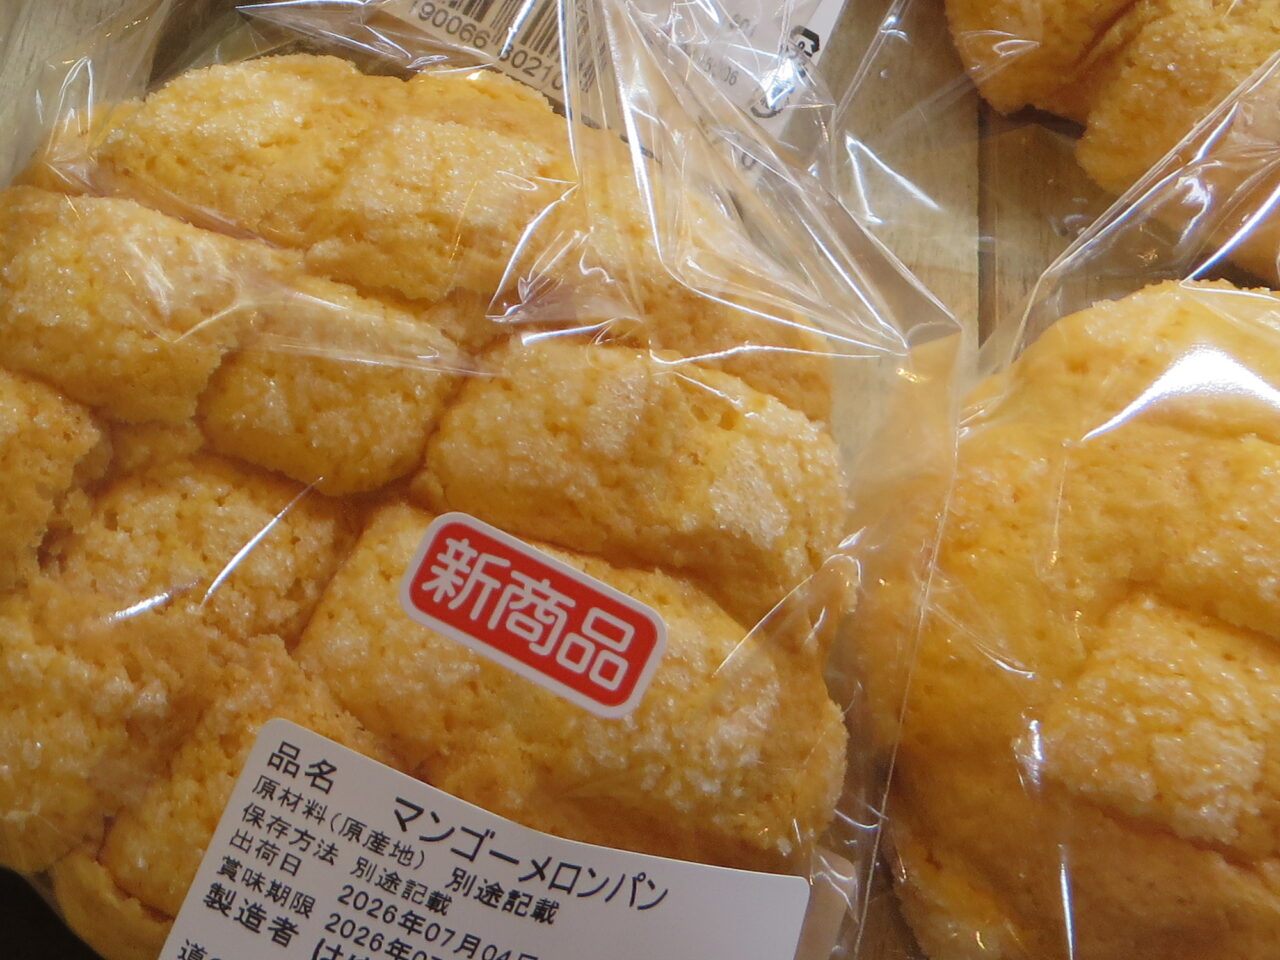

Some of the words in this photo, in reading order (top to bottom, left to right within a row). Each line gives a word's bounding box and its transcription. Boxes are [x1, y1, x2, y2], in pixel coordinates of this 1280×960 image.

[422, 538, 635, 691] 新商品
[216, 855, 316, 920] 賞味期限
[242, 803, 339, 867] 保存方法
[349, 856, 453, 917] 別途記載
[251, 774, 426, 871] 原材料(原産地)
[444, 867, 561, 925] 別途記載
[267, 740, 338, 795] 品名
[393, 796, 669, 911] マンゴーメロンパン
[202, 882, 300, 949] 製造者
[228, 828, 303, 877] 出荷日
[336, 885, 539, 960] 2026年07月04
